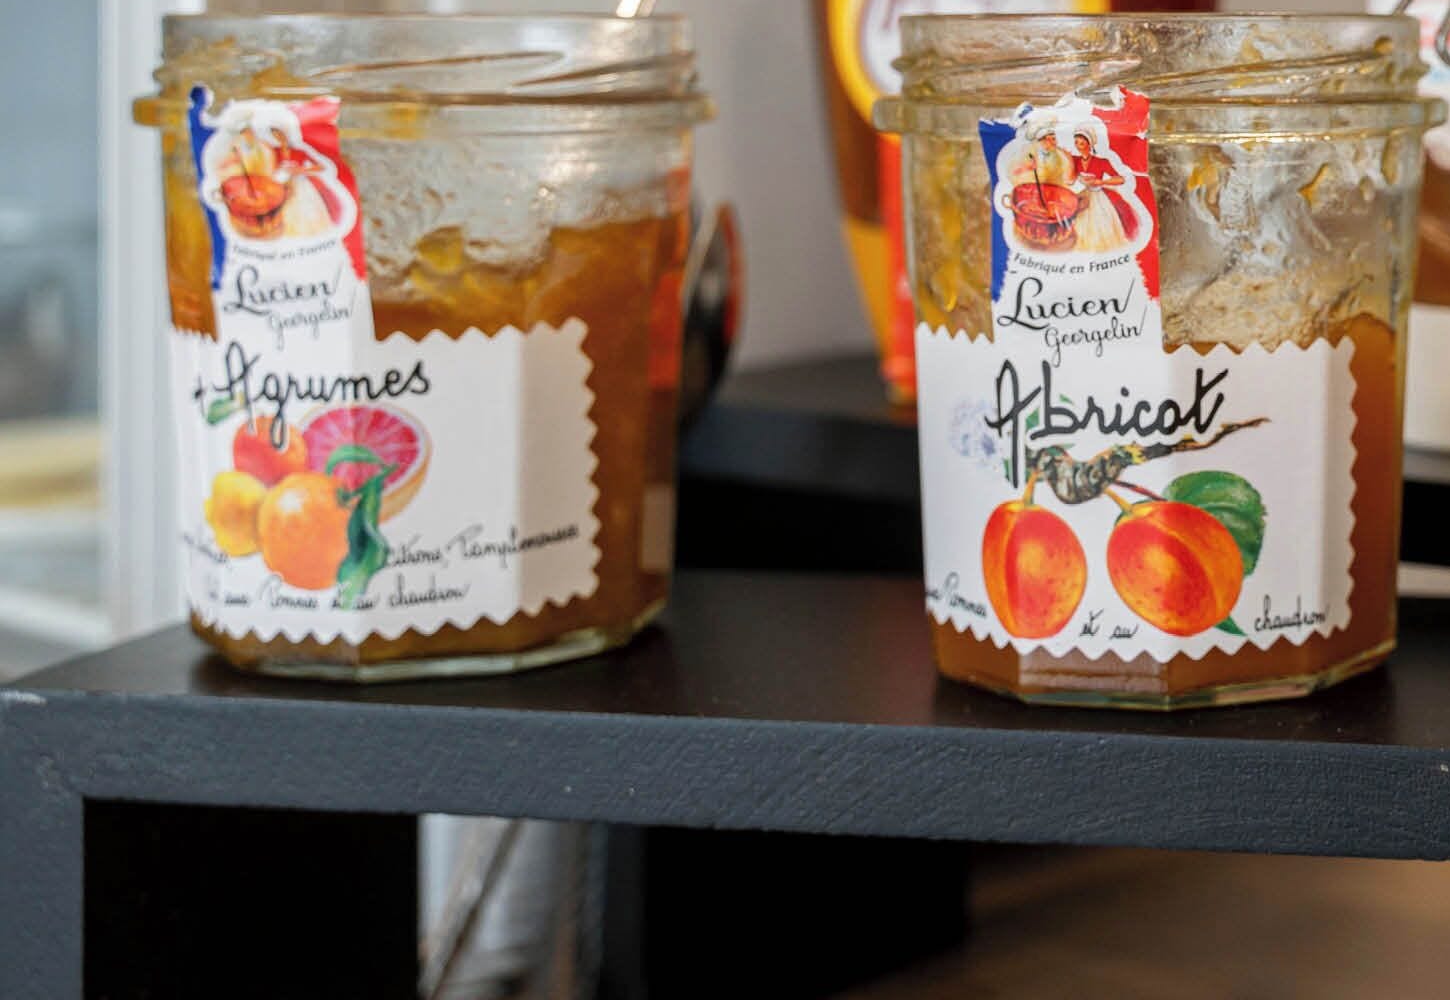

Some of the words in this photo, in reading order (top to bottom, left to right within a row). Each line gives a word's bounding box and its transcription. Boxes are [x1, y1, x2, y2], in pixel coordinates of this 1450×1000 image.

[223, 263, 344, 316] Lucien
[1014, 252, 1066, 275] Fabriqué
[1069, 264, 1085, 275] en
[1089, 253, 1131, 273] France
[997, 276, 1136, 331] Lucien
[1044, 305, 1148, 369] Georgelin
[212, 340, 431, 450] Agrumes
[984, 358, 1229, 489] Abricot
